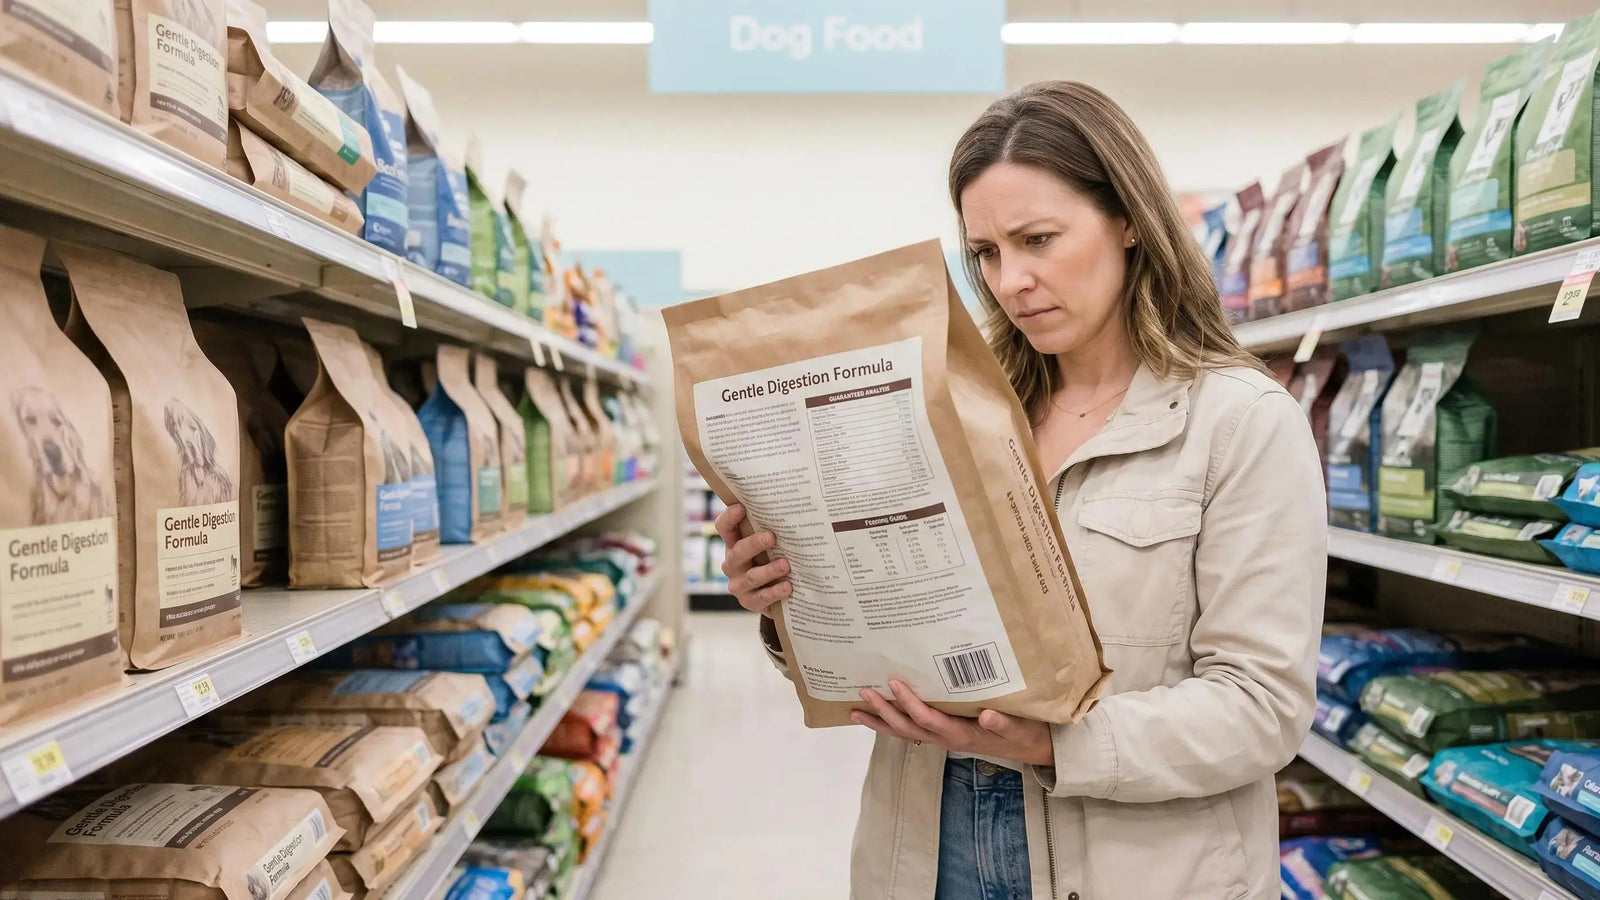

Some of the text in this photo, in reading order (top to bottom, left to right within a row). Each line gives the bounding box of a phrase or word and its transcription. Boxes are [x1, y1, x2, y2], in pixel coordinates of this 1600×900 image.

[156, 23, 219, 72] Gentle Digestion
[156, 38, 195, 66] Formula
[730, 15, 924, 60] Dog Food
[721, 358, 894, 403] Gentle Digestion Formula
[828, 390, 865, 402] GUARANTEED
[164, 509, 236, 532] Gentle Digestion
[1008, 438, 1029, 483] Gentle
[1028, 485, 1056, 555] Digestion
[1055, 555, 1076, 612] Formula
[8, 528, 109, 558] Gentle Digestion
[165, 531, 208, 550] Formula
[10, 556, 69, 581] Formula
[65, 808, 108, 836] Gentle
[82, 804, 132, 837] Formula
[262, 834, 305, 874] Gentle Digestion
[269, 862, 290, 886] Formula
